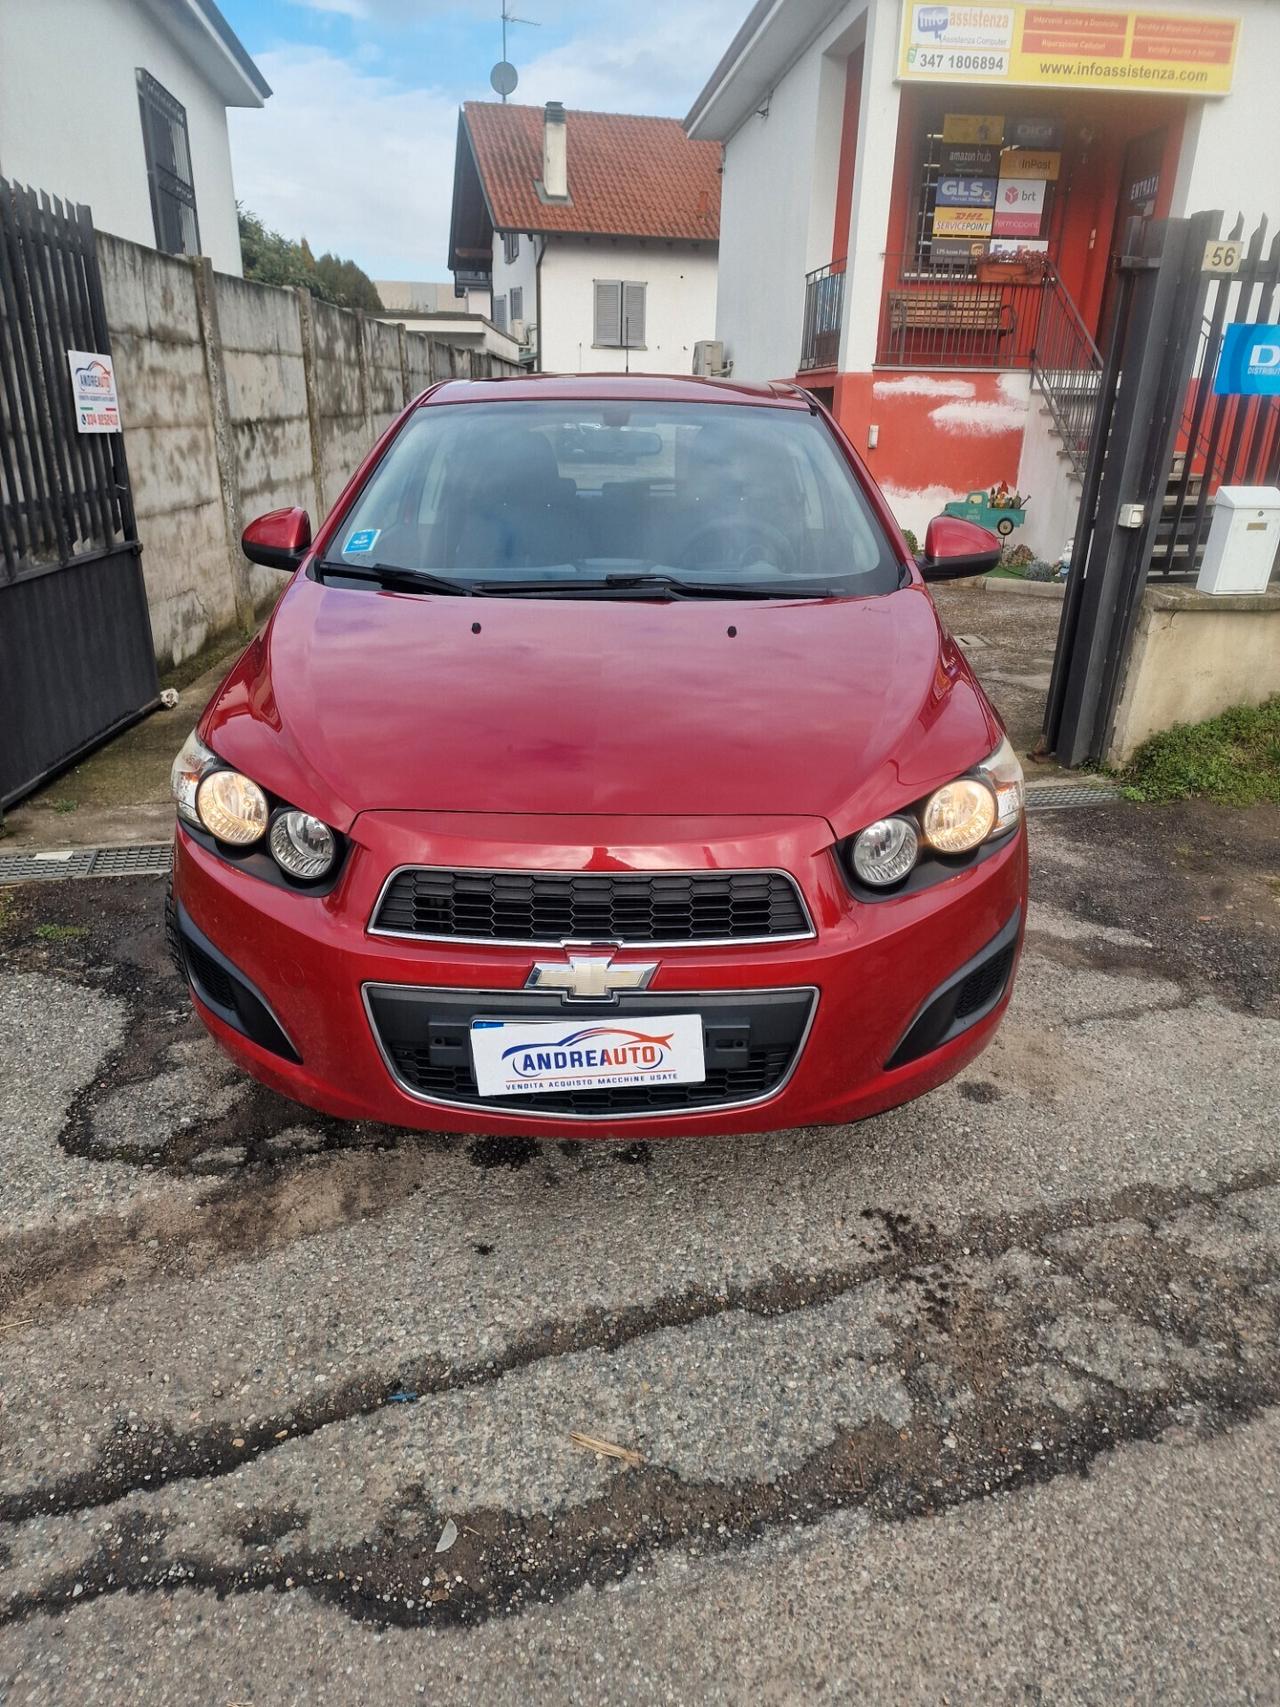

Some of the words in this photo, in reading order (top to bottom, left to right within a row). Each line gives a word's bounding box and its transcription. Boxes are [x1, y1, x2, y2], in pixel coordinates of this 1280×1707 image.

[949, 9, 1009, 28] assistenza
[920, 54, 943, 68] 347
[949, 55, 1004, 70] 1806894
[1039, 62, 1209, 83] www.infoassistenza.com
[949, 151, 976, 161] amazon
[977, 149, 992, 161] hub
[1021, 159, 1051, 169] InPost
[941, 181, 983, 196] GLS
[1022, 191, 1037, 201] brt
[954, 212, 984, 221] DHL
[936, 222, 989, 231] SERVICEPOINT
[1211, 246, 1236, 267] 56
[522, 1045, 656, 1072] ANDREAUTO
[505, 1081, 544, 1092] VENDITA
[548, 1078, 593, 1089] ACQUISTO
[597, 1075, 645, 1086] MACCHINE
[649, 1073, 678, 1082] USATE
